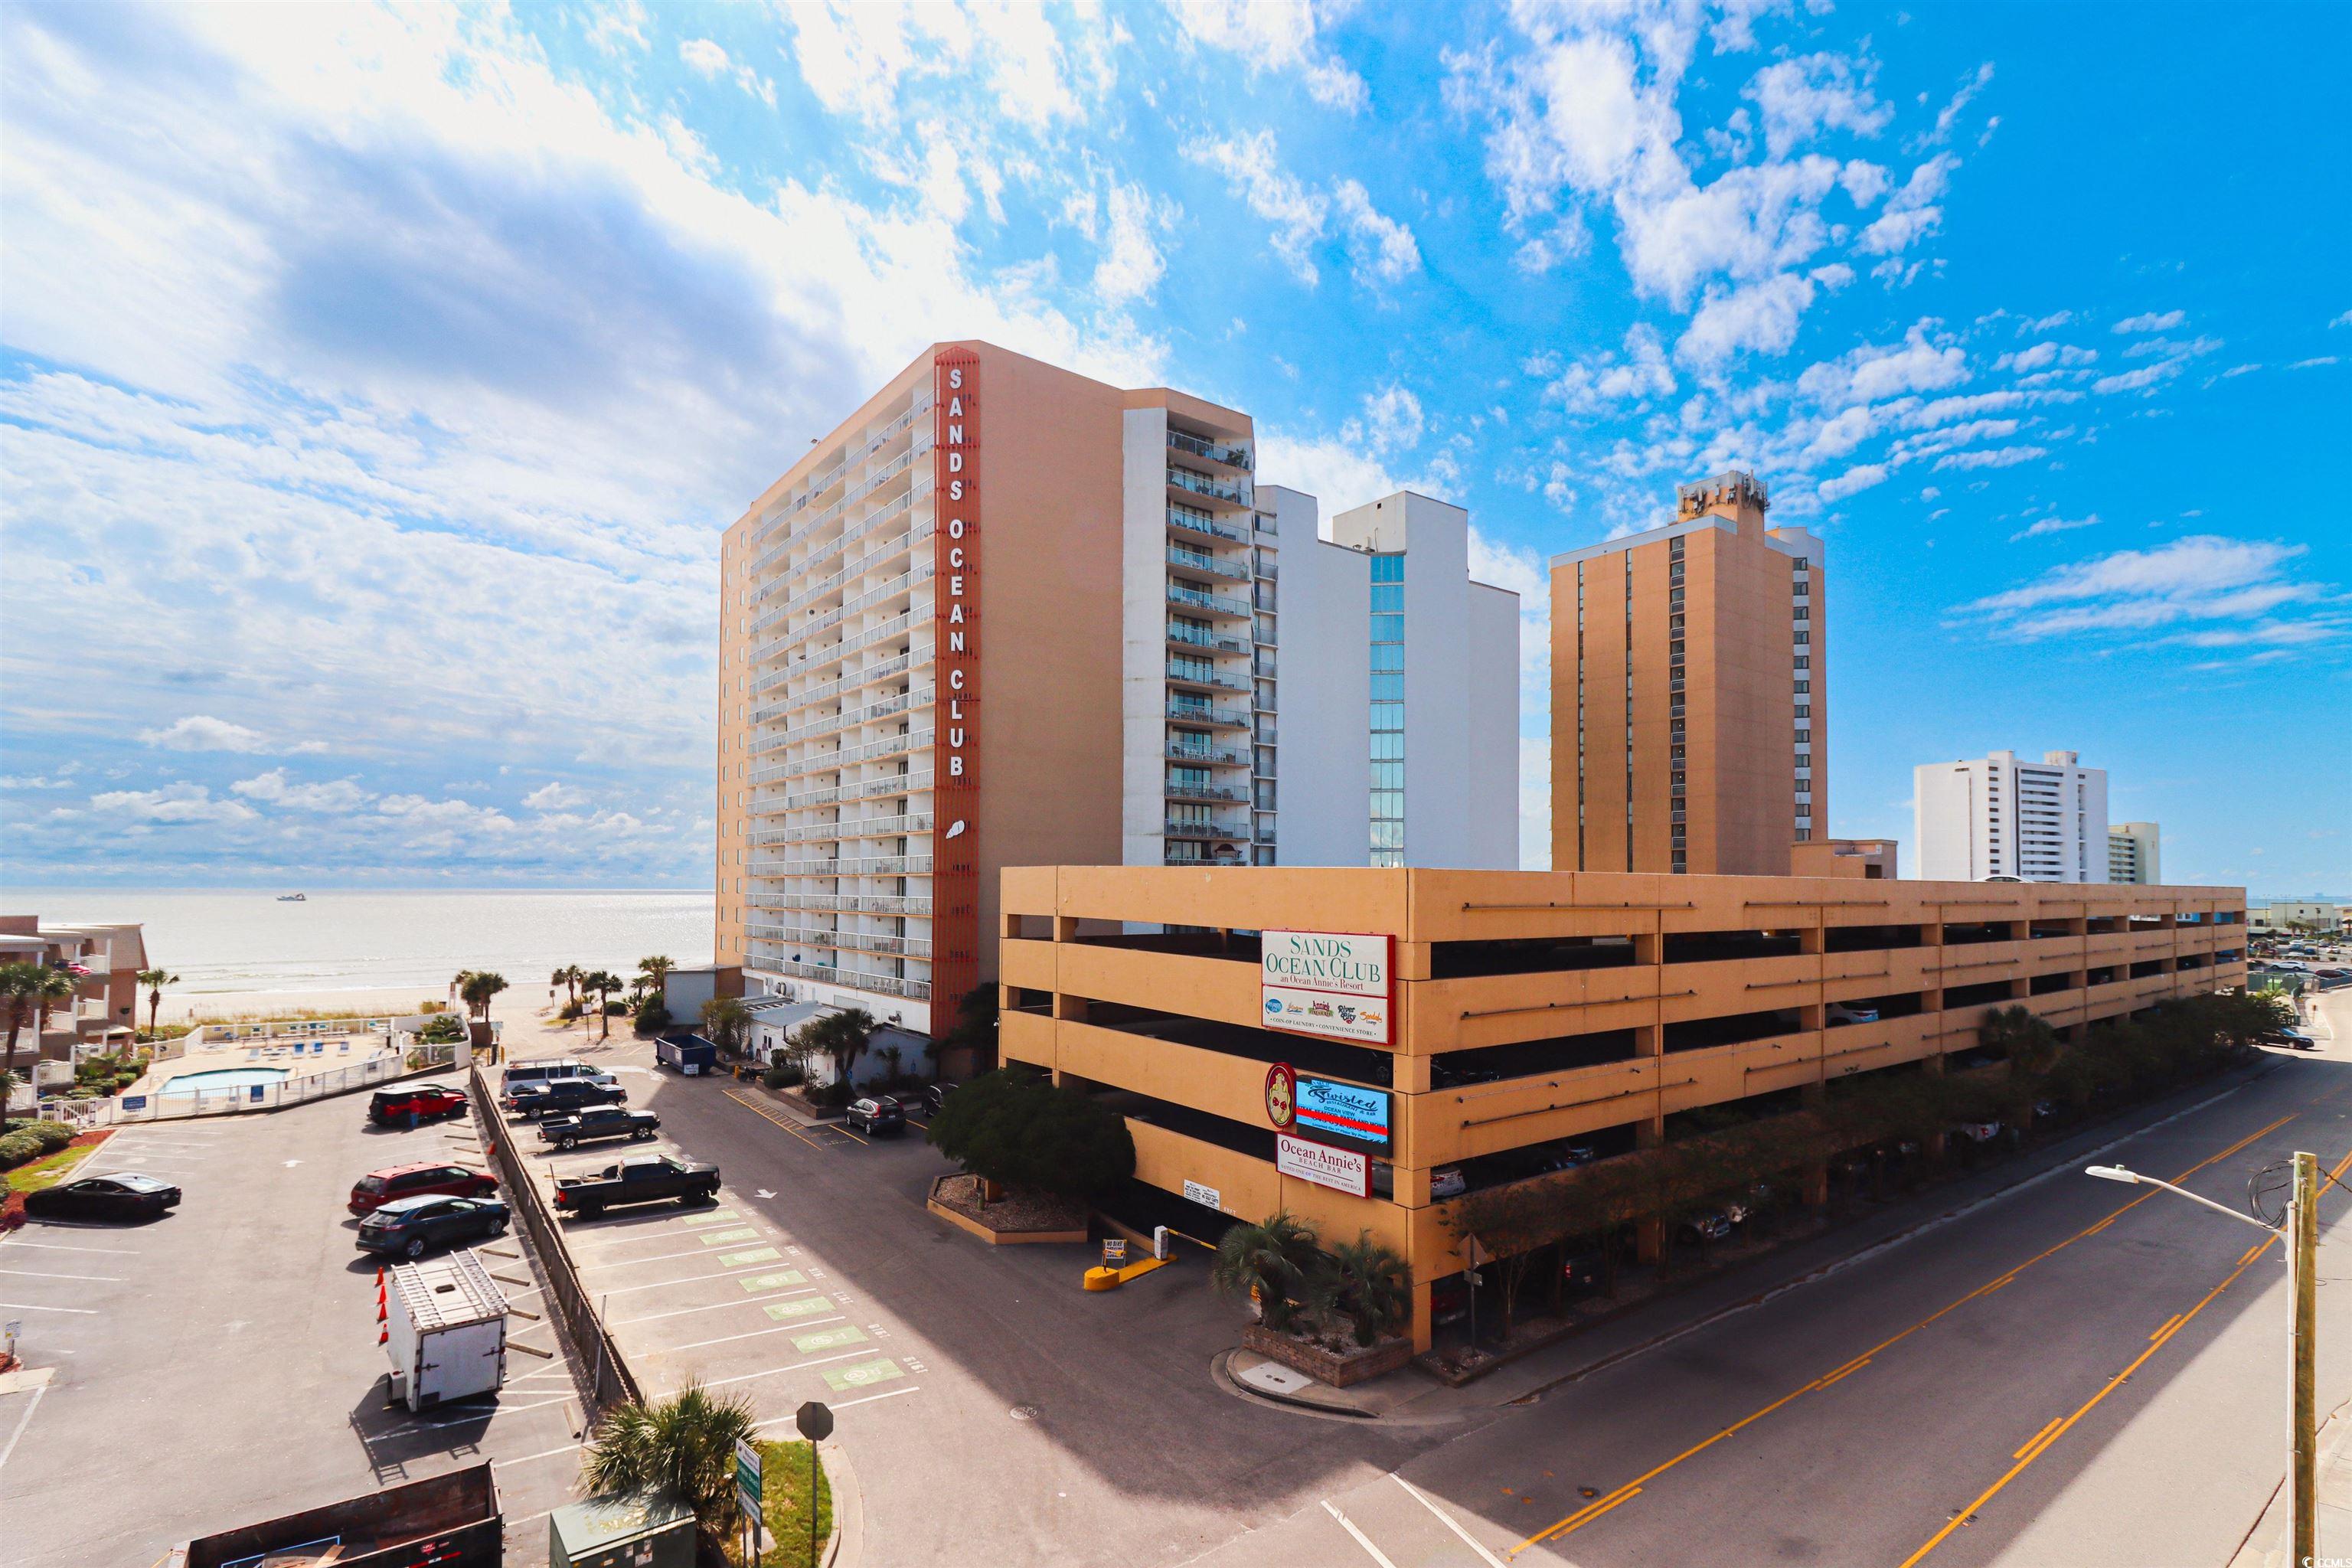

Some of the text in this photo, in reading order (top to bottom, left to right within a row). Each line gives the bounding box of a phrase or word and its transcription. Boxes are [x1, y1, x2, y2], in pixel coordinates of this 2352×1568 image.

[949, 368, 964, 776] SANDS OCEAN CLUB
[1290, 934, 1351, 958] SANDS
[1266, 952, 1380, 982] OCEAN CLUB
[1290, 974, 1312, 985] Ocean
[1312, 976, 1338, 988] Annie's
[1340, 978, 1364, 991] Resort
[1338, 1004, 1356, 1014] River
[1292, 1020, 1315, 1028] LAUNDRY
[1318, 1024, 1355, 1034] CONVENIENCE
[1323, 1106, 1341, 1115] OCEAN
[1281, 1139, 1362, 1173] Ocean Annie's
[1298, 1157, 1342, 1174] BEACH BAR
[1281, 1164, 1295, 1172] VOTED
[1340, 1182, 1361, 1192] AMERICA
